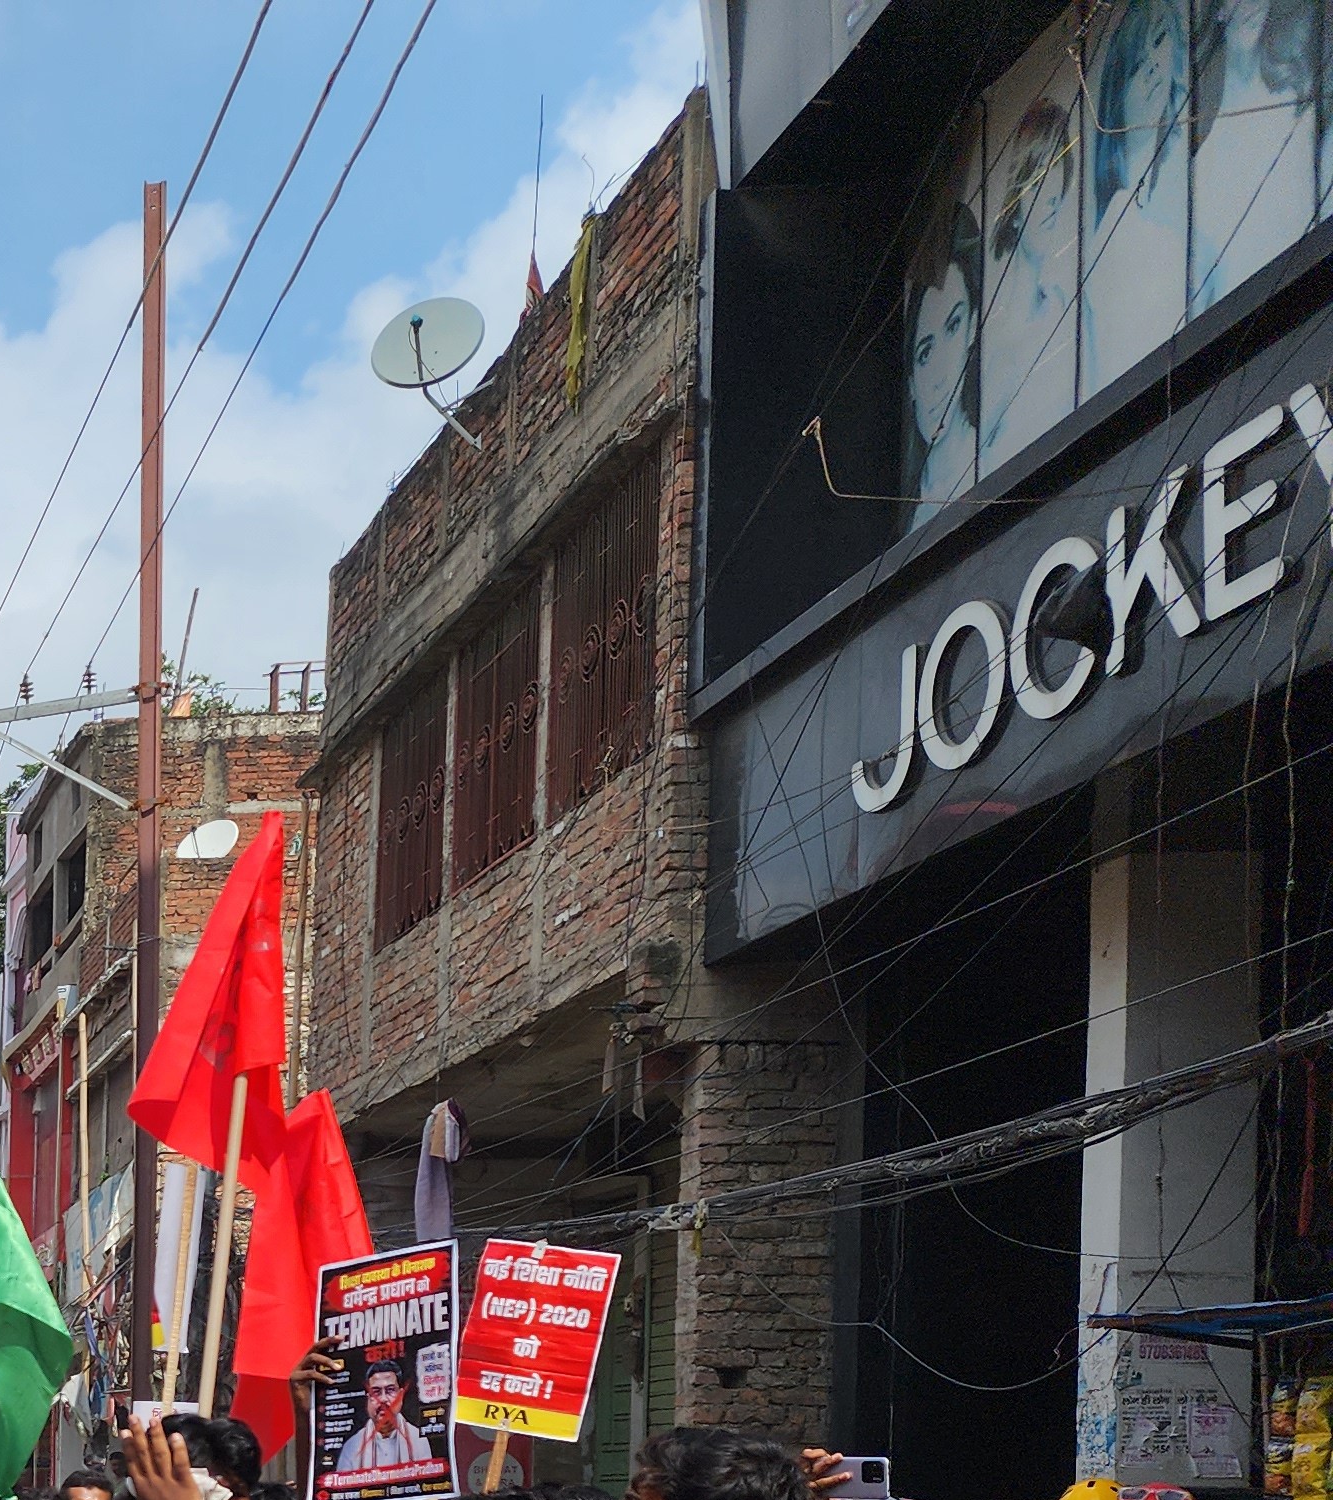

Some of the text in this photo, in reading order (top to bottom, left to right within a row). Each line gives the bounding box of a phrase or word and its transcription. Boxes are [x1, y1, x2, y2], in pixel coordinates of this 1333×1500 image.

[484, 1257, 608, 1292] नई शिक्षा नीति
[380, 1278, 416, 1300] प्रधान
[416, 1276, 430, 1293] को
[325, 1292, 449, 1352] TERMINATE
[482, 1292, 591, 1328] (NEP) 2020
[513, 1335, 541, 1359] को
[503, 1374, 543, 1399] करो
[484, 1404, 529, 1425] RYA
